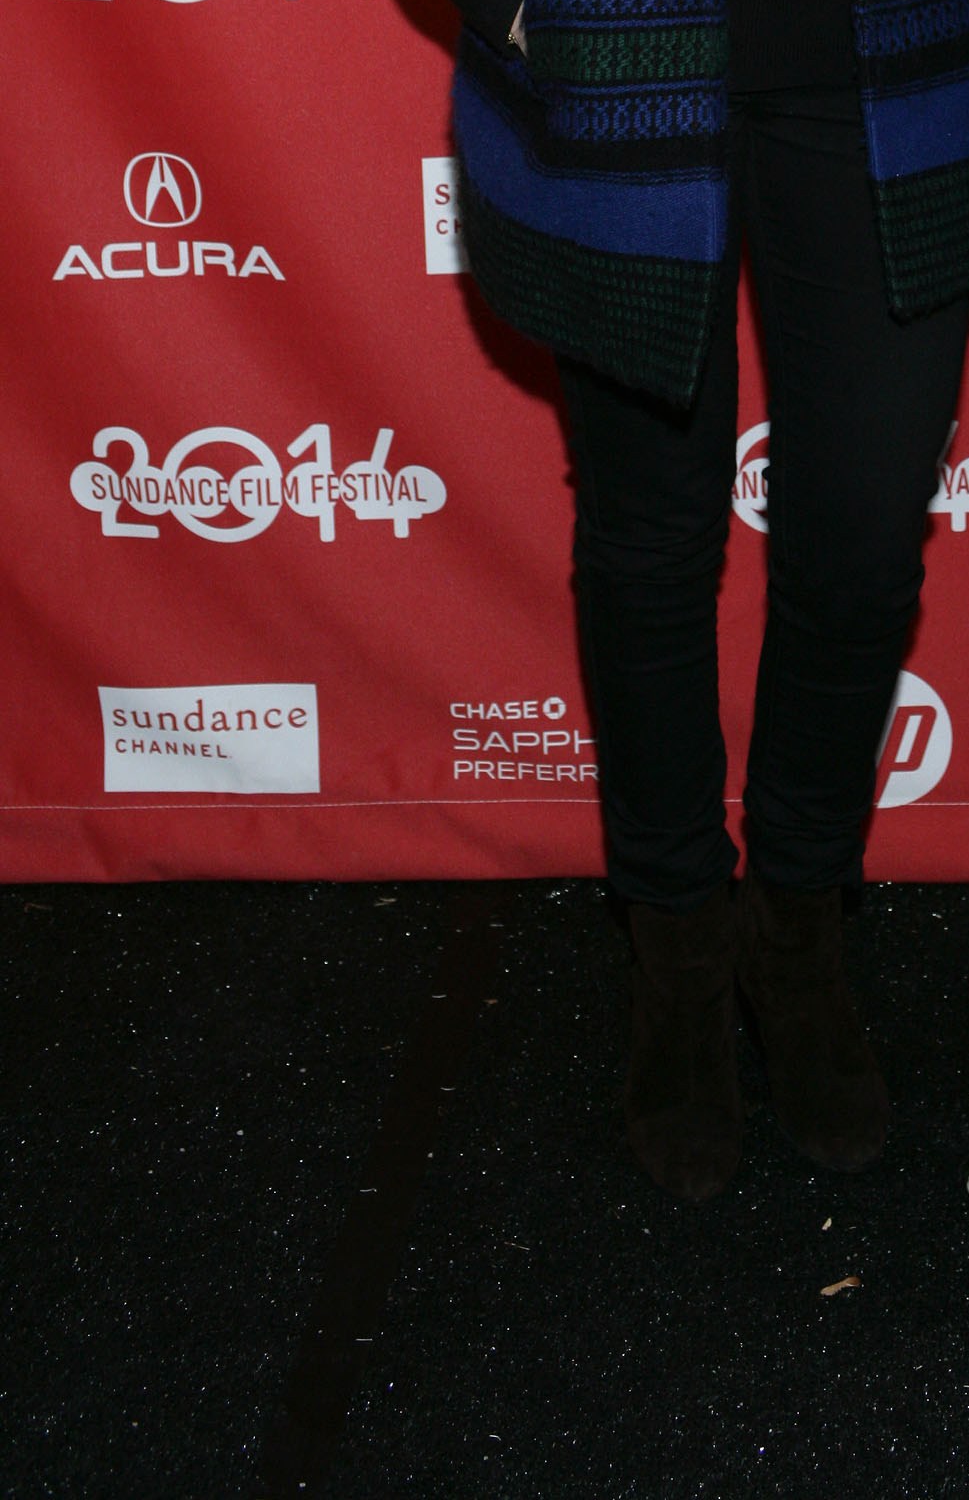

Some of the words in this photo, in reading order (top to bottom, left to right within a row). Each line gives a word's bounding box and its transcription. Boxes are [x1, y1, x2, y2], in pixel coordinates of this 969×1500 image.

[53, 241, 286, 280] ACURA
[92, 473, 229, 506] SUNDANCE
[241, 478, 299, 507] FILM
[311, 473, 427, 505] FESTIVAL
[93, 424, 422, 543] 2014
[113, 698, 307, 732] sundance
[450, 701, 538, 719] CHASE
[115, 739, 227, 758] CHANNEL
[453, 728, 598, 755] SAPPH
[454, 760, 600, 782] PREFERR
